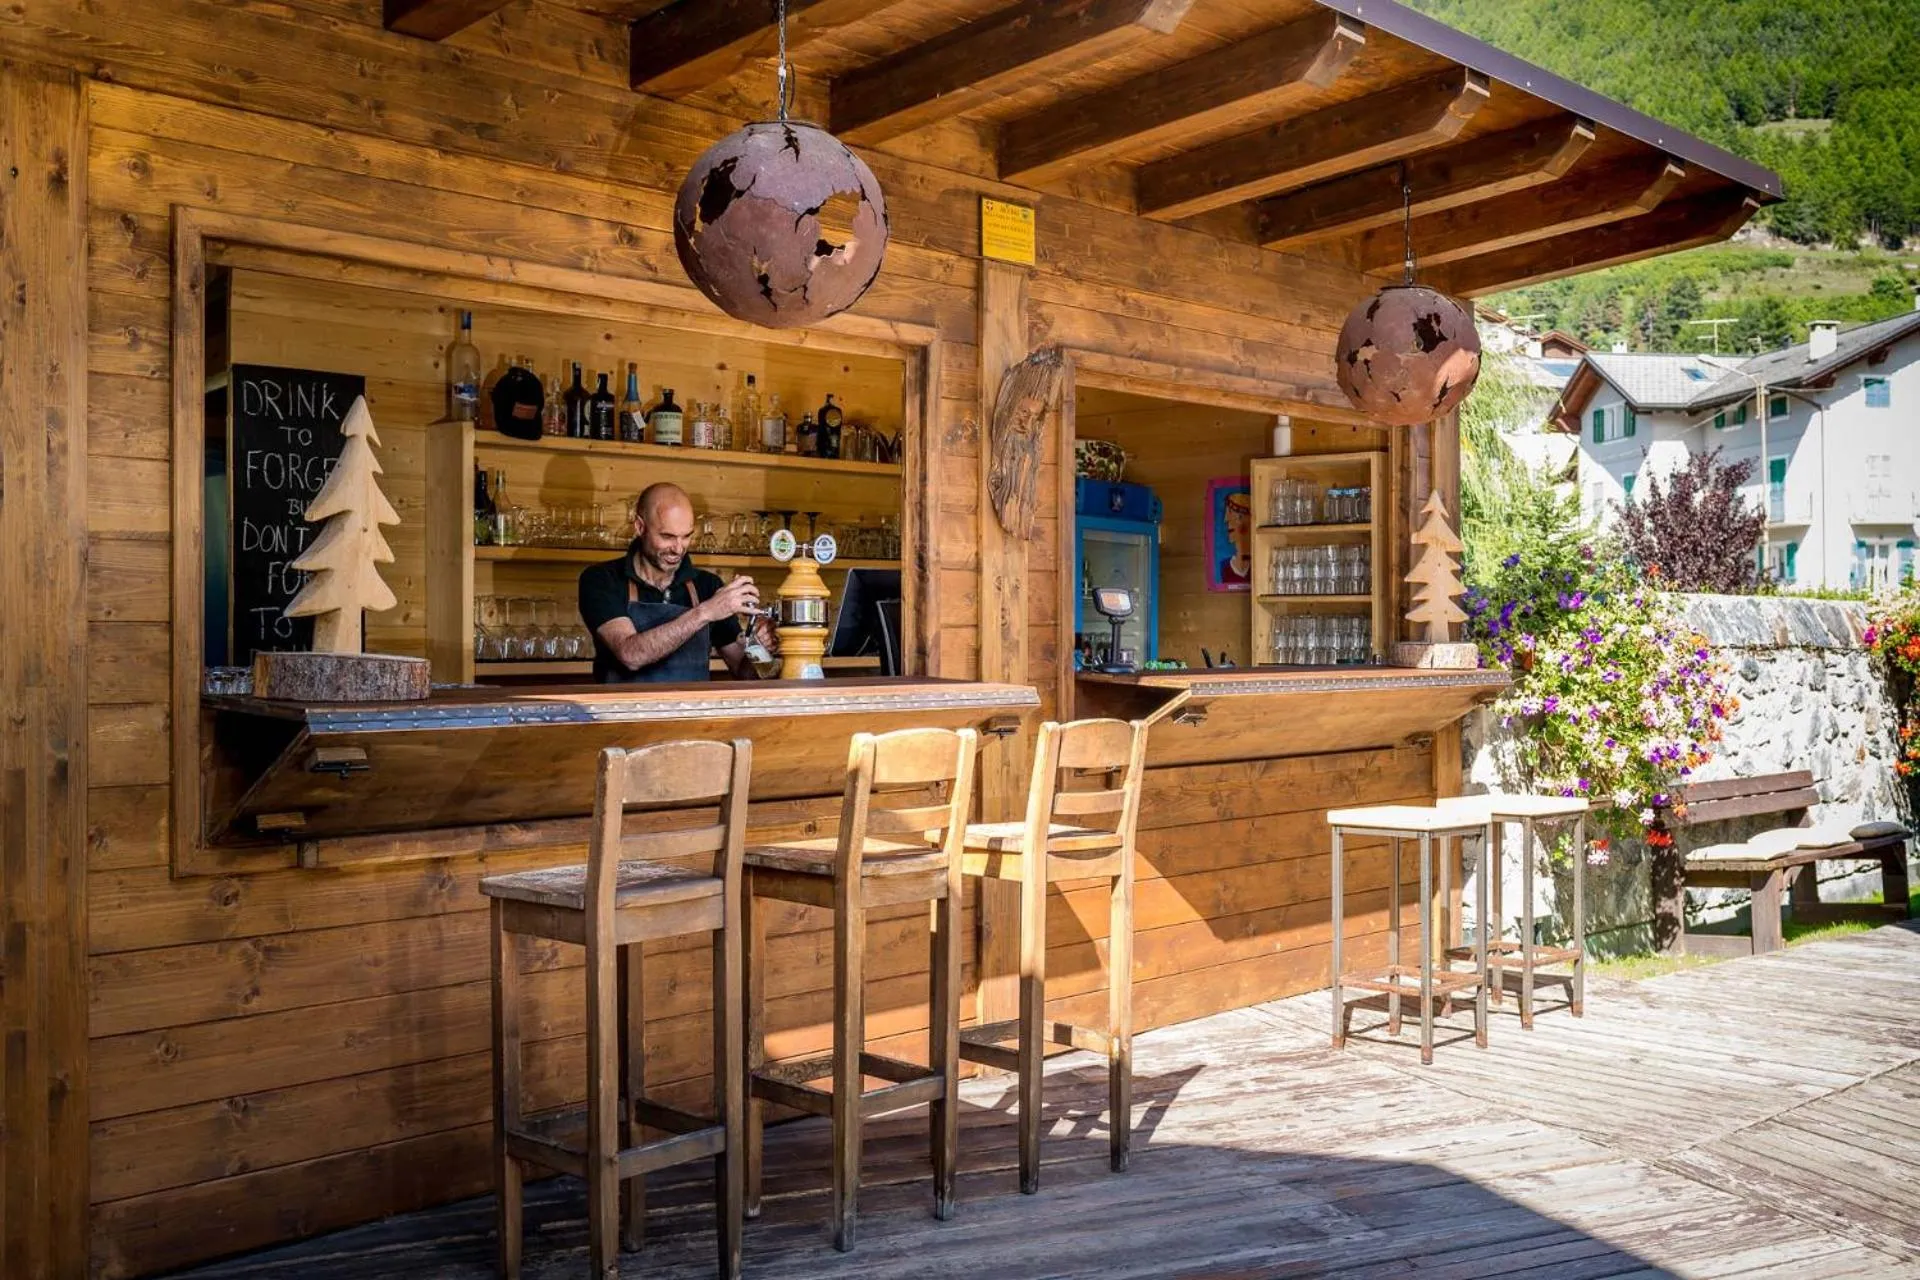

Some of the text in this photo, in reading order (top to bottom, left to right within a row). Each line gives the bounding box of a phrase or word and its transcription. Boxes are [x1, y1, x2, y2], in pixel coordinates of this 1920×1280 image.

[243, 379, 340, 420] DRINK
[279, 425, 313, 446] TO
[242, 517, 310, 553] DON'T
[249, 606, 293, 640] TO
